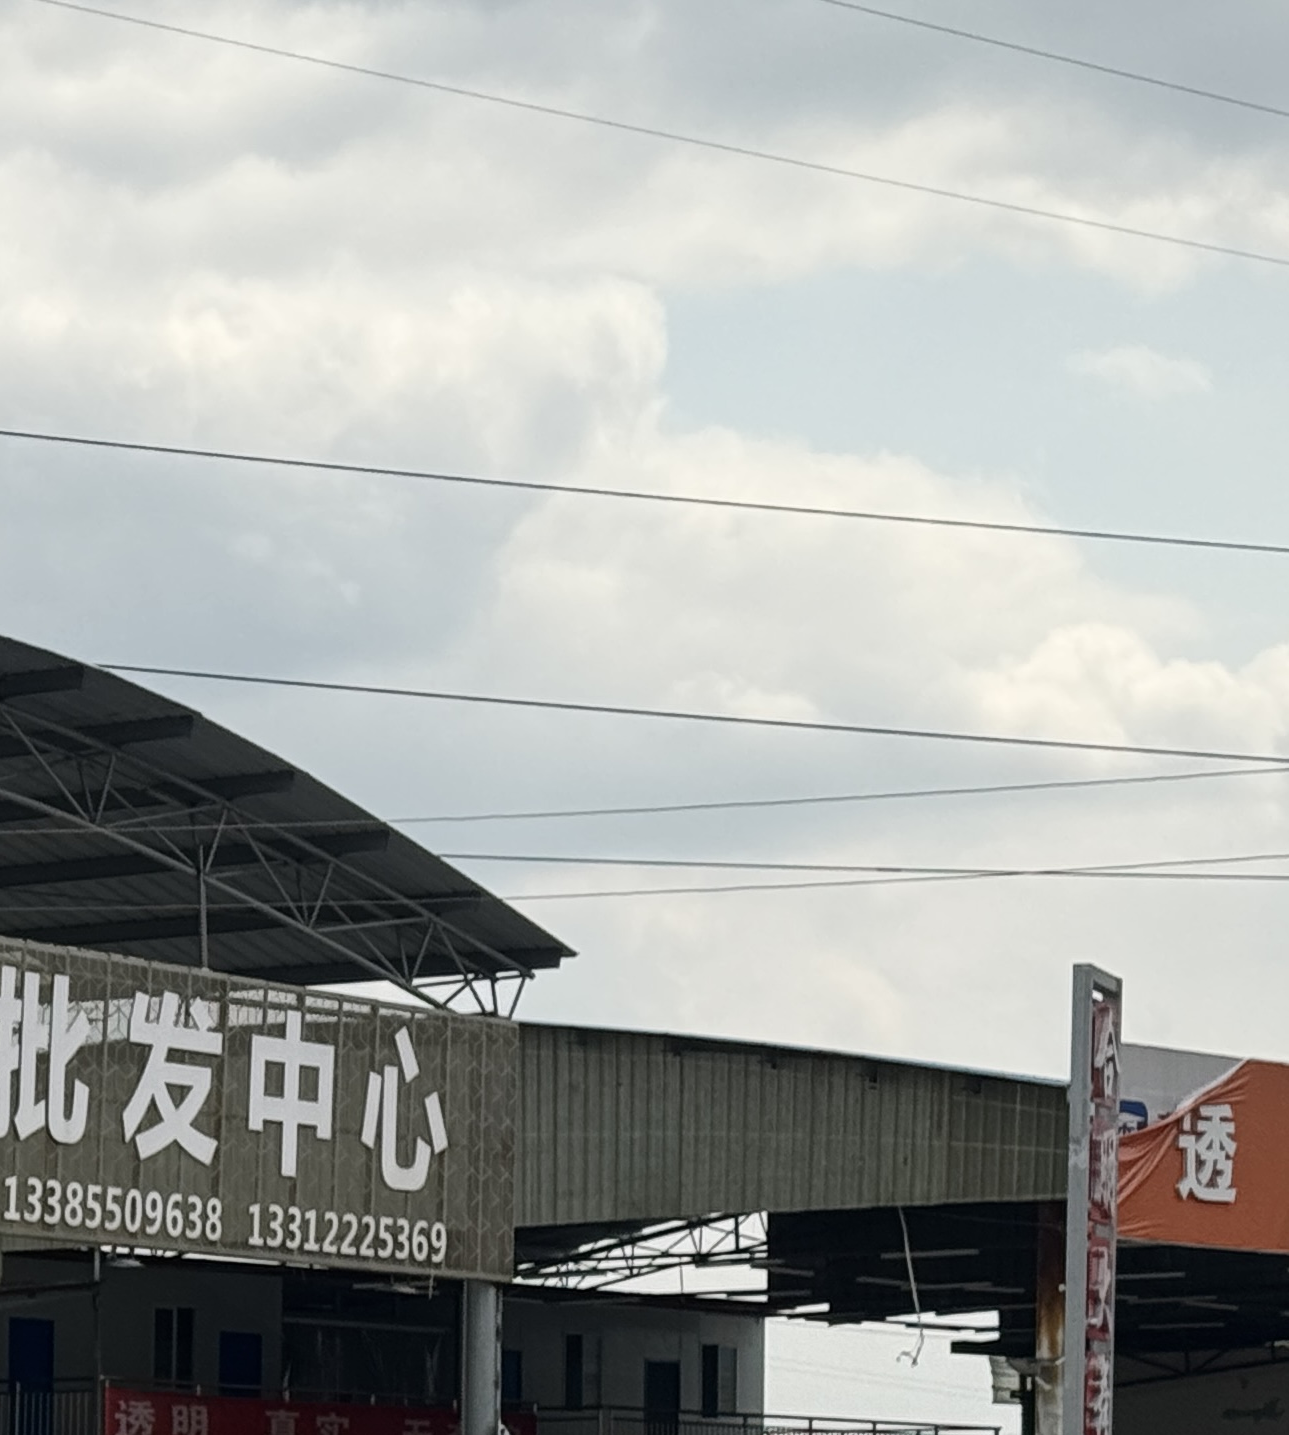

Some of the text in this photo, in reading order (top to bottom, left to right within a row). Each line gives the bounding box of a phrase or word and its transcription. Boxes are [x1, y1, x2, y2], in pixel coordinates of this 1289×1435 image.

[1178, 1104, 1237, 1203] 透
[3, 1175, 448, 1263] 13385509638 13312225369
